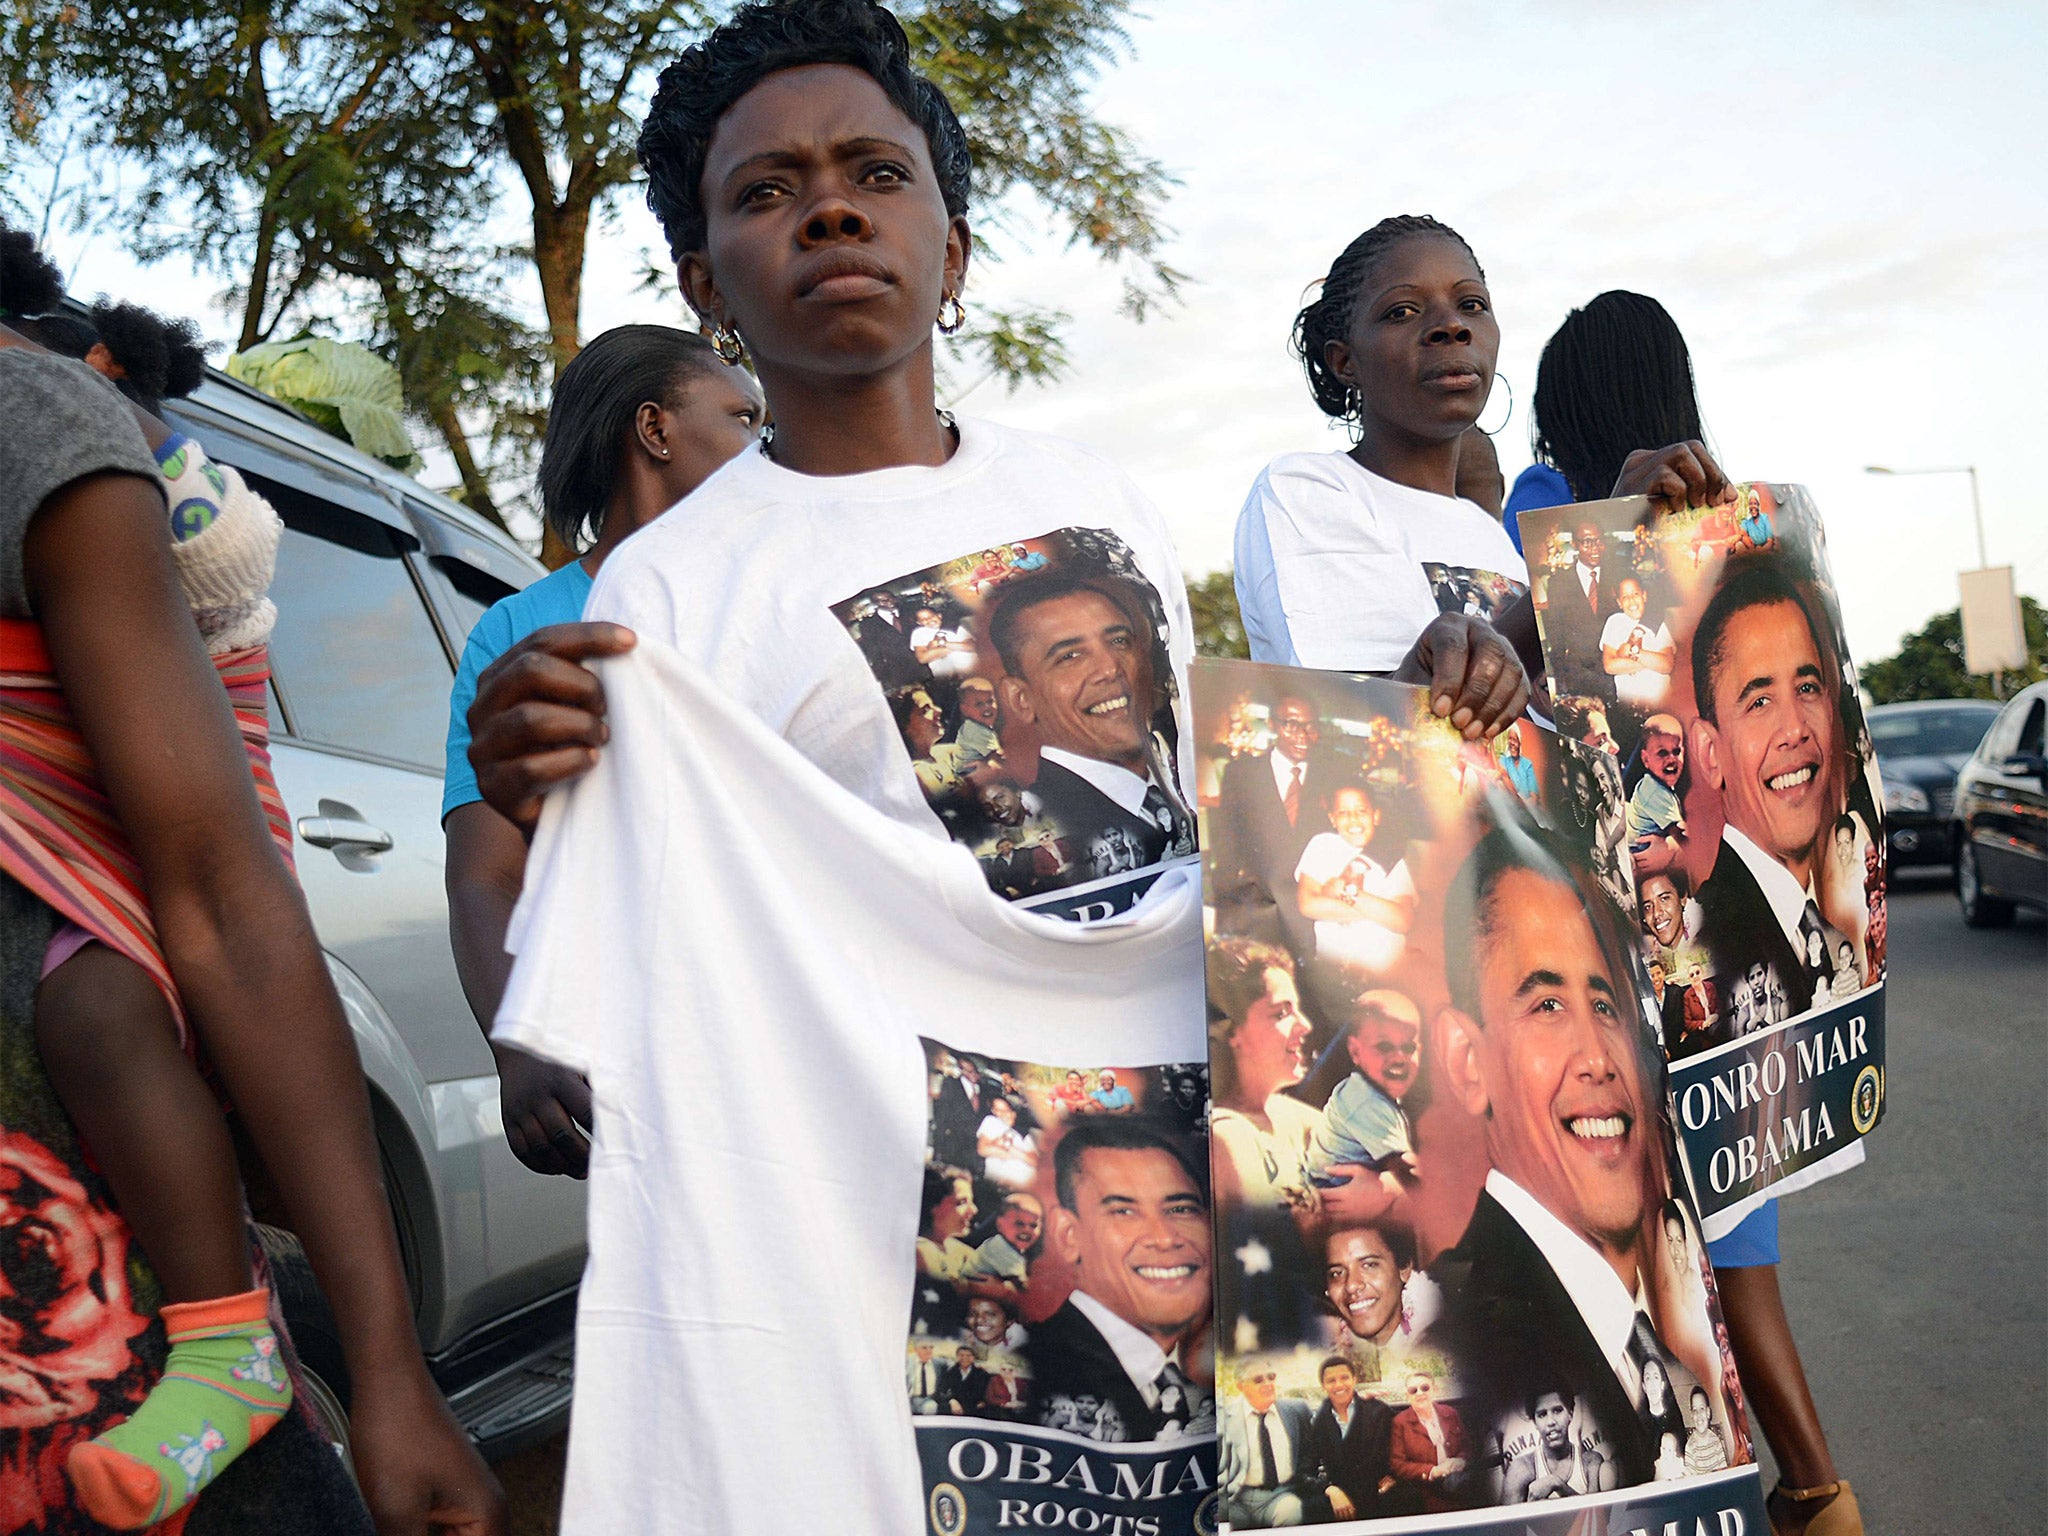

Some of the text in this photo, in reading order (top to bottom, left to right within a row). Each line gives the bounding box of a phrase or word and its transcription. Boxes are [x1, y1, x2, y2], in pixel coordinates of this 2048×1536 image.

[1795, 1016, 1868, 1084] MAR
[1709, 1102, 1835, 1194] OBAMA
[948, 1438, 1212, 1500] OBAMA
[996, 1499, 1160, 1536] ROOTS
